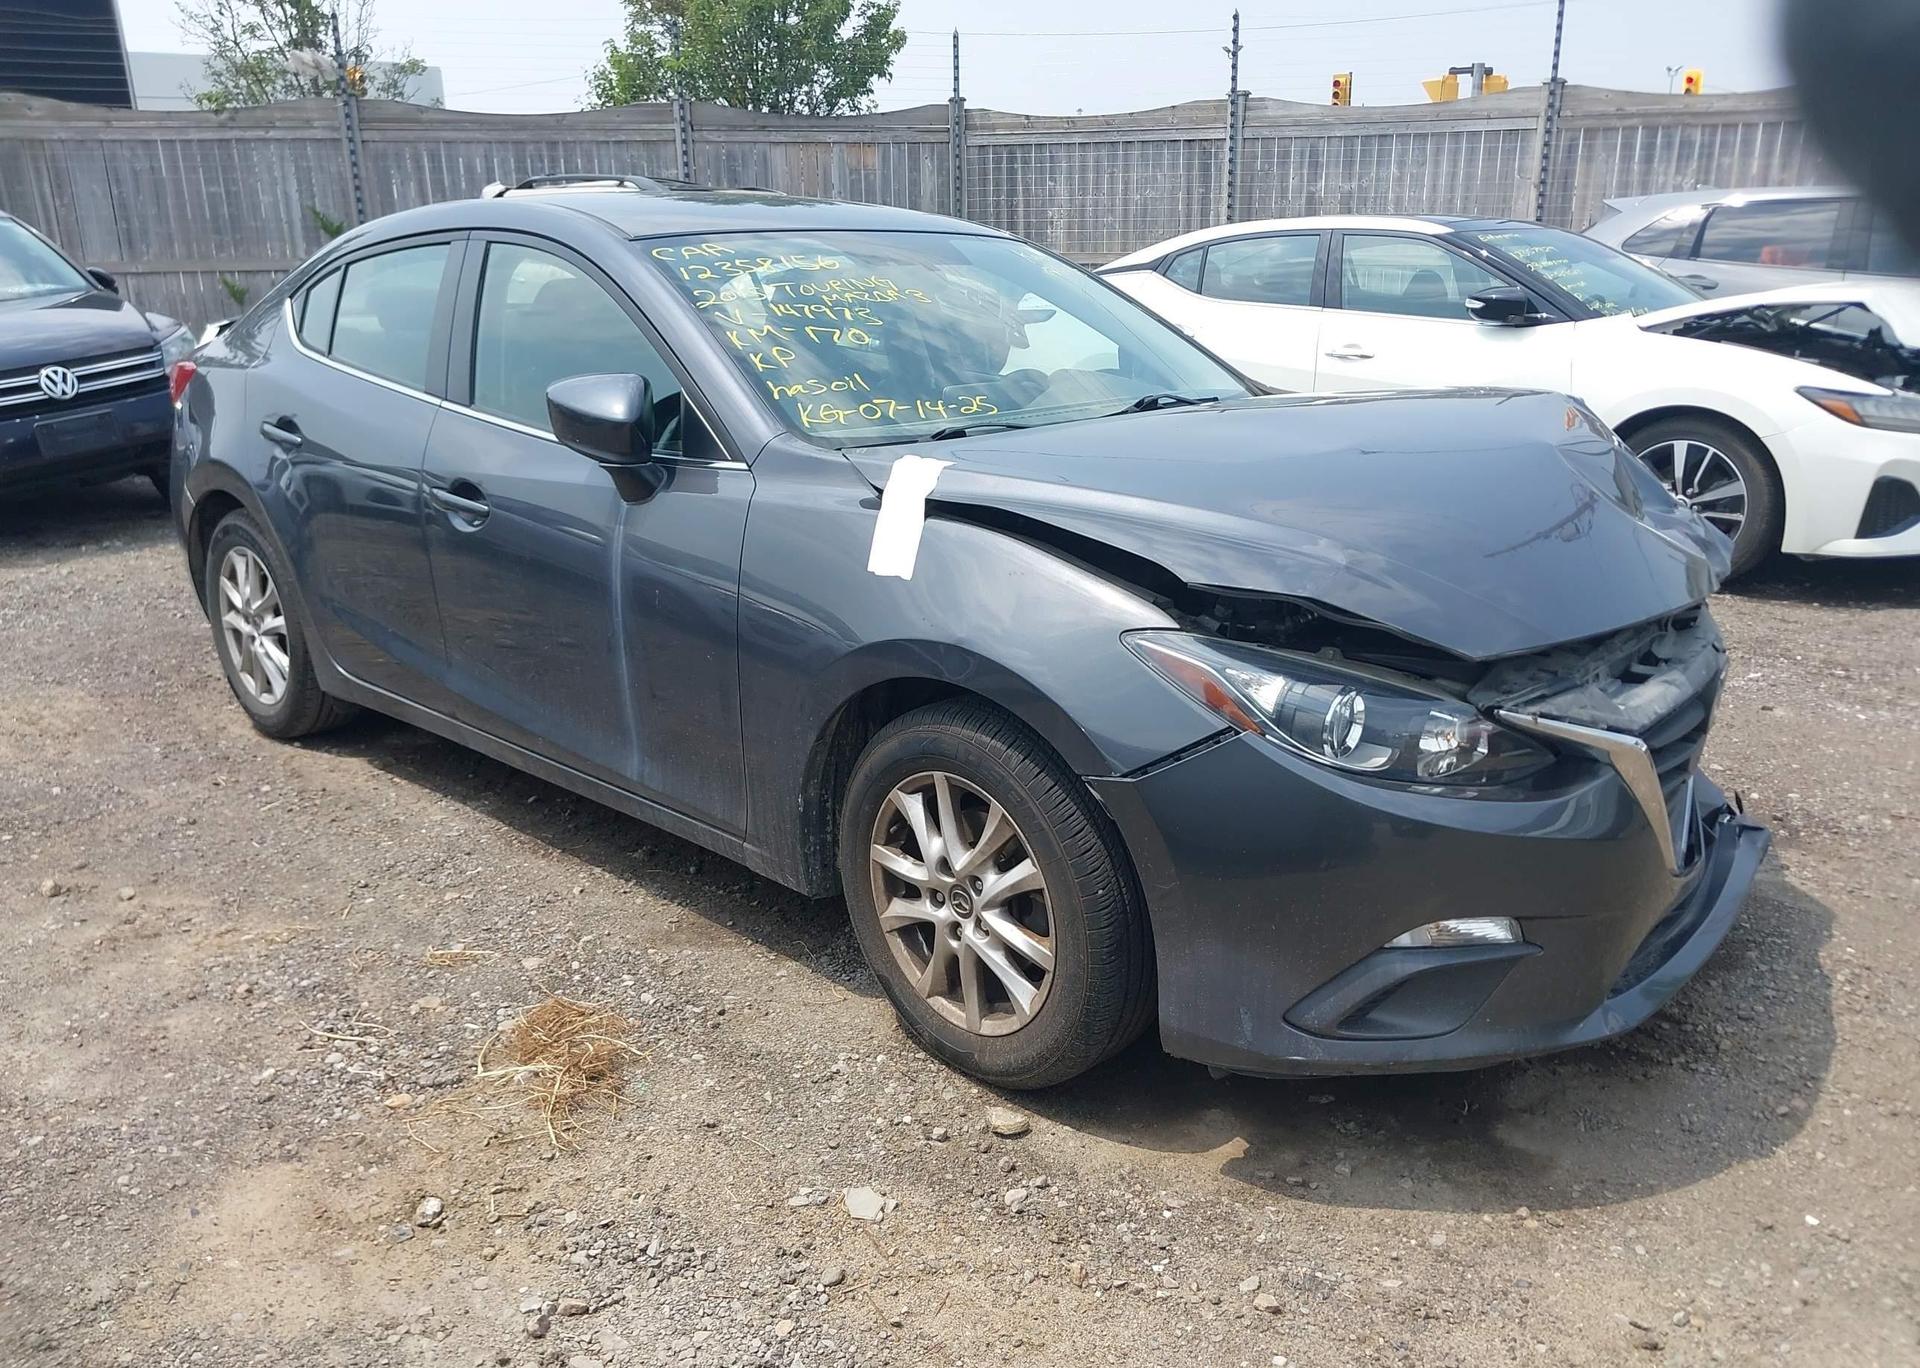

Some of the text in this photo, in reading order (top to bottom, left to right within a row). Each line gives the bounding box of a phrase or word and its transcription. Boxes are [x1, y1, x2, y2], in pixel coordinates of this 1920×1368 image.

[651, 243, 736, 260] CAA
[679, 255, 841, 281] 12358156
[768, 275, 899, 299] TOURING
[749, 346, 797, 373] KP
